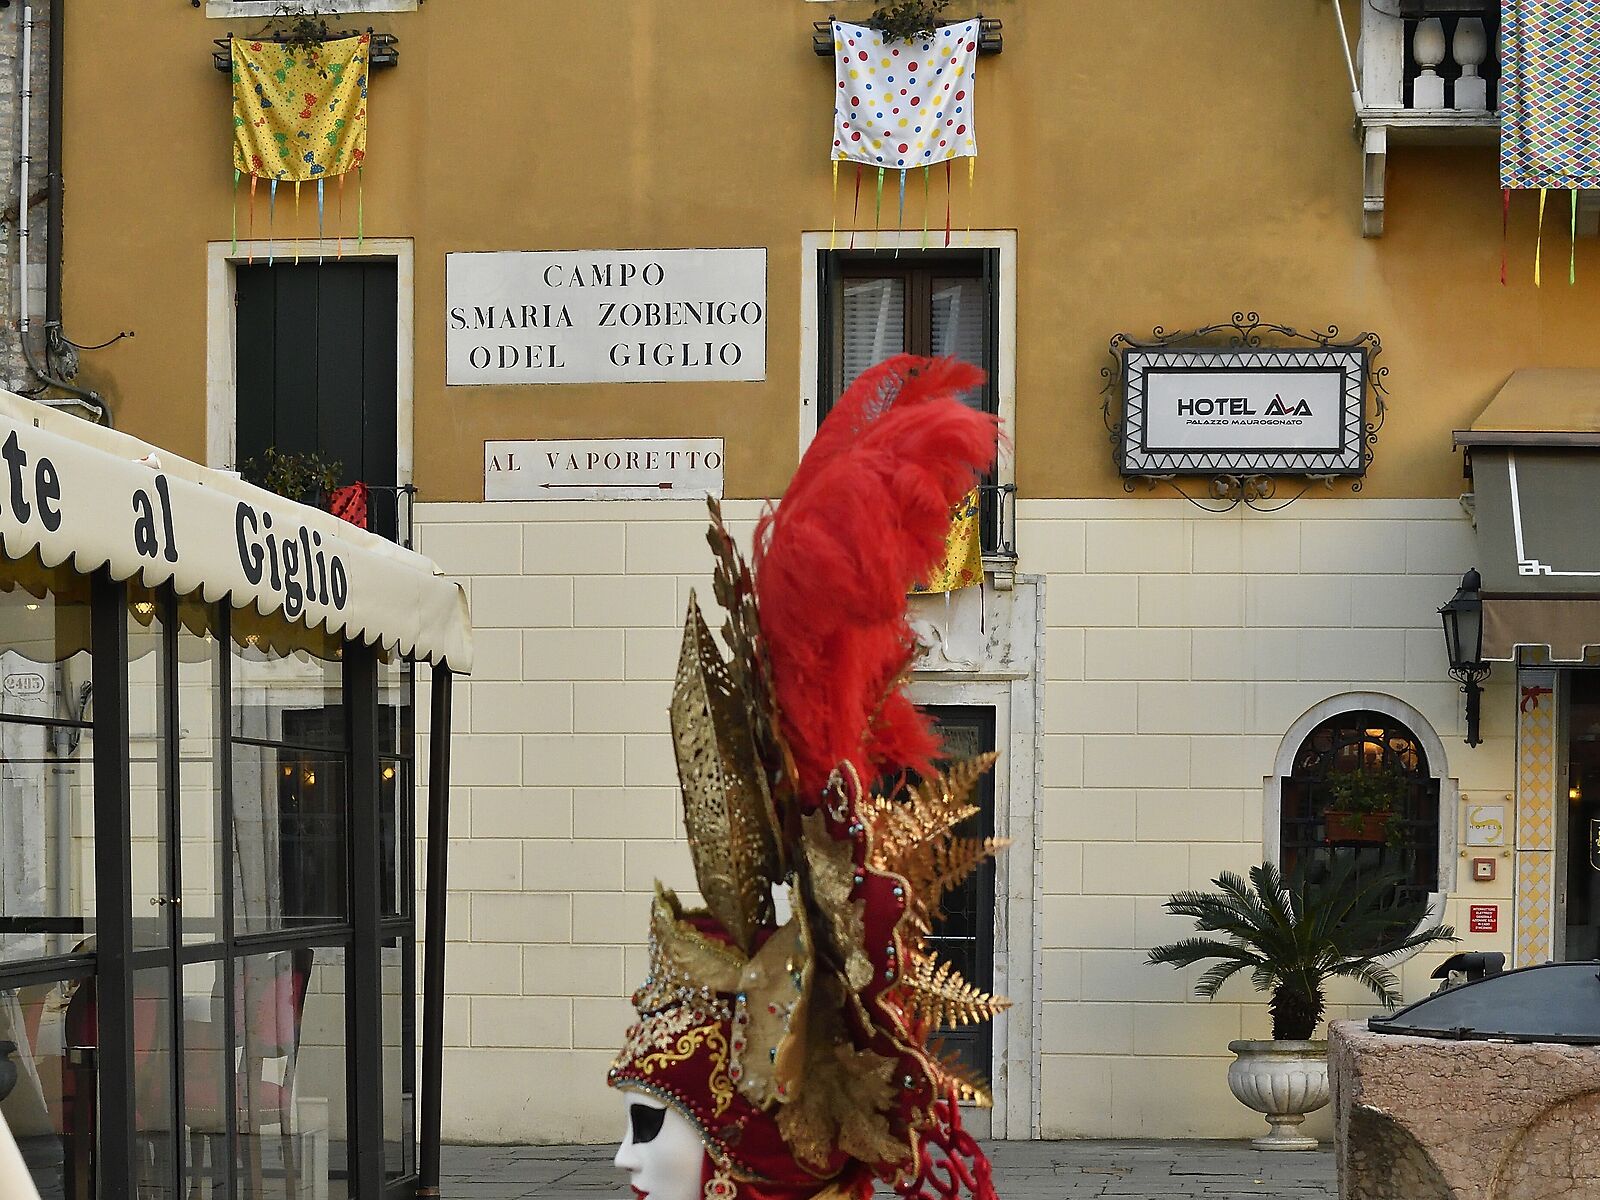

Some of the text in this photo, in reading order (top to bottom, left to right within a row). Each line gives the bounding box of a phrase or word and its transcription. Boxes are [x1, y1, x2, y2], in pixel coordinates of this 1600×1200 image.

[543, 262, 665, 288] CAMPO
[450, 301, 762, 330] S.MARIA ZOBENIGO
[469, 342, 743, 369] ODEL GIGLIO
[1177, 398, 1257, 416] HOTEL
[488, 451, 721, 472] AL VAPORETTO
[0, 429, 348, 617] te al Giglio
